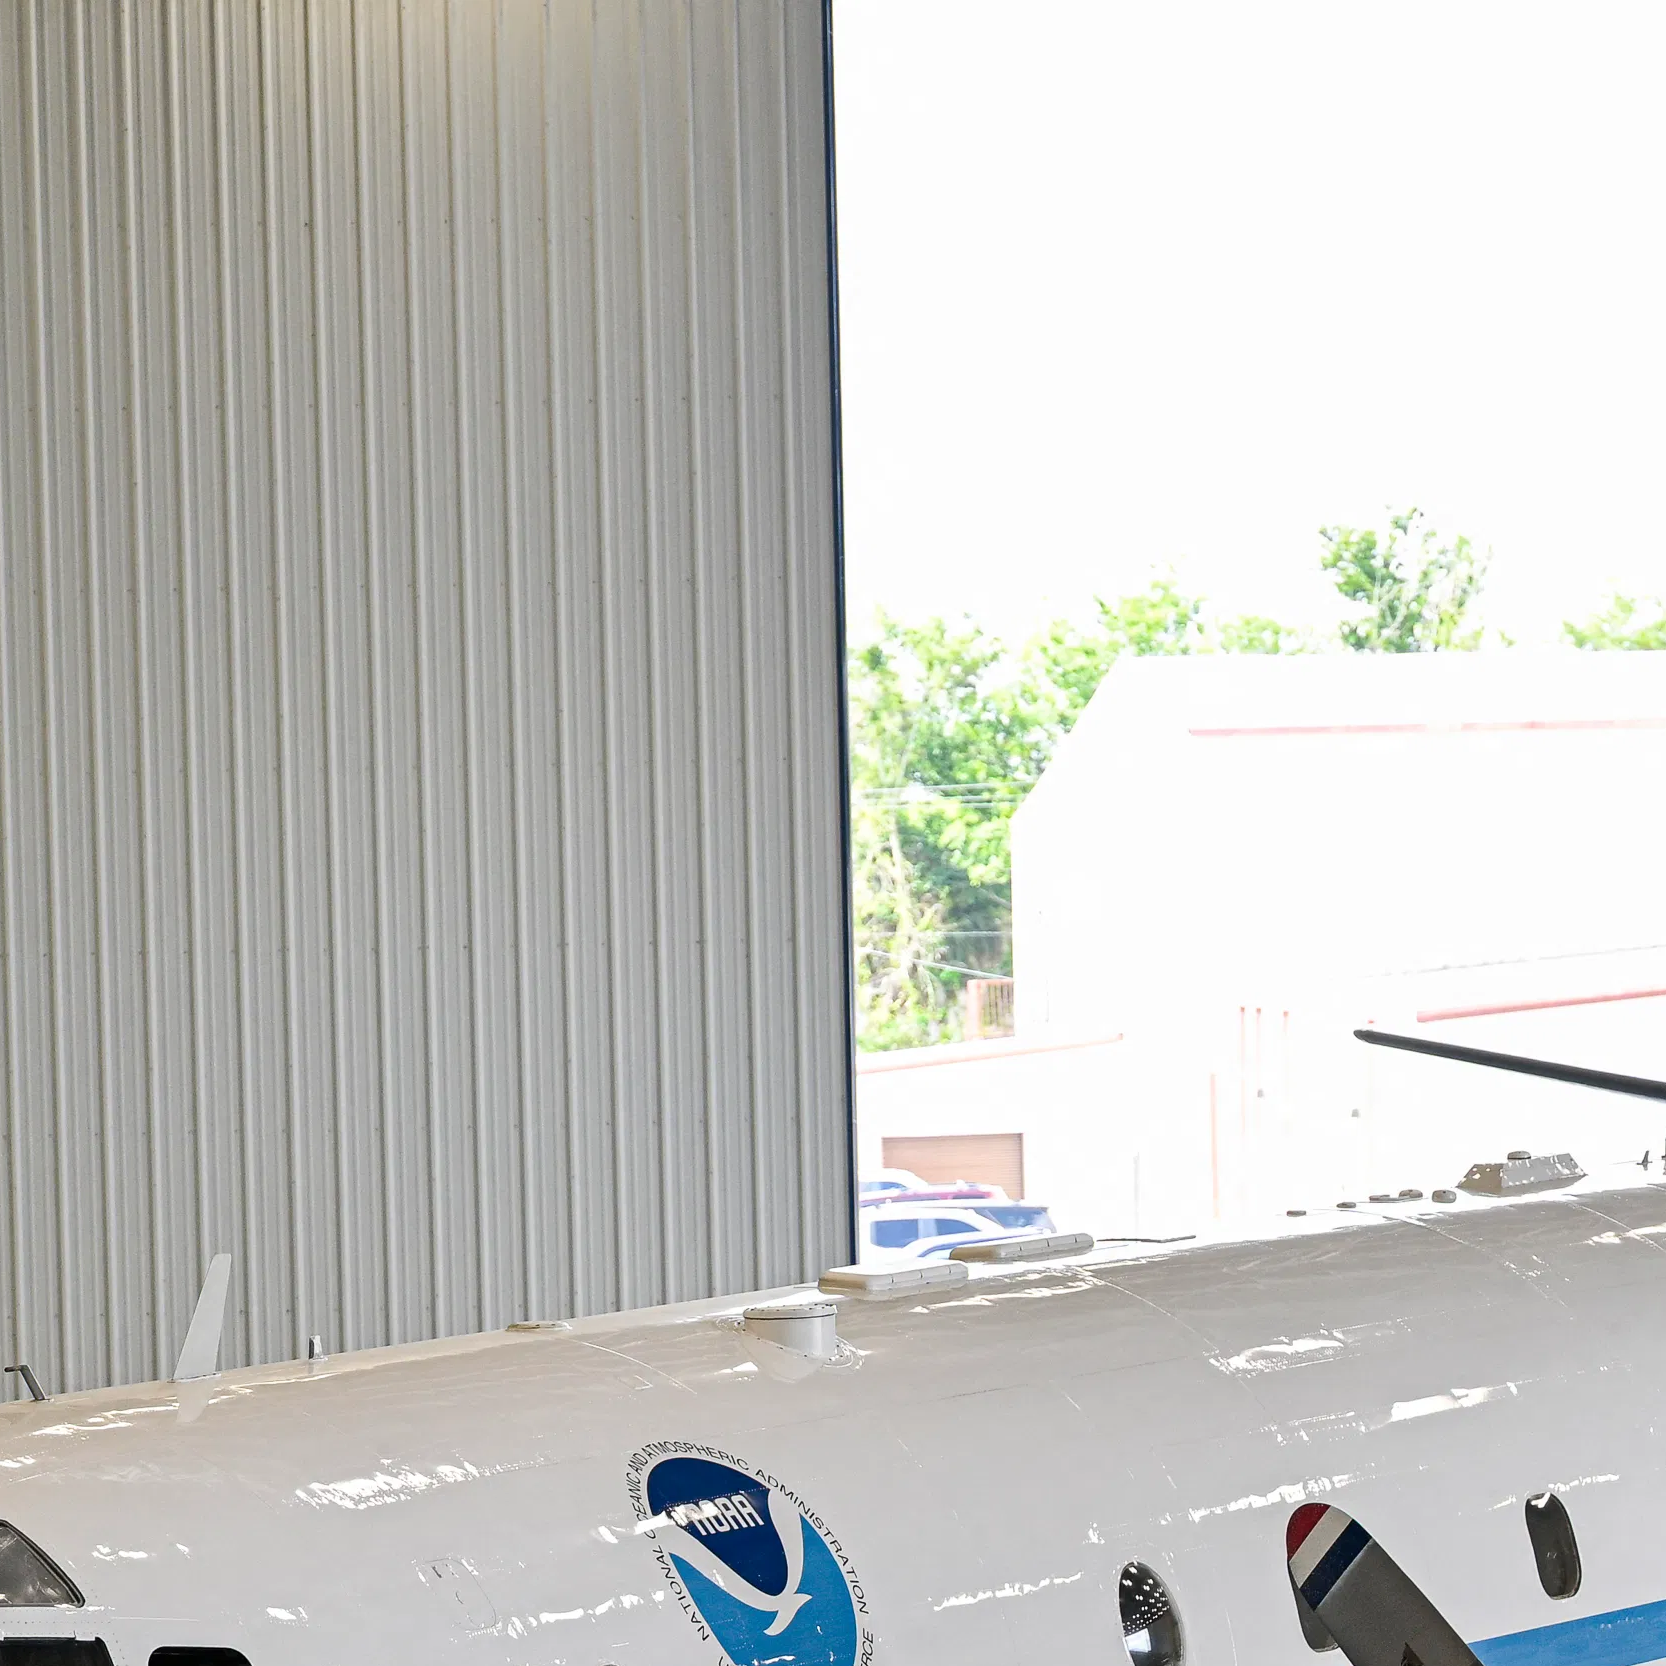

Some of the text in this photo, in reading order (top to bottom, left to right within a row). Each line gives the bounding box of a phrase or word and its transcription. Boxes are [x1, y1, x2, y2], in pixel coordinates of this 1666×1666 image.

[628, 1452, 649, 1476] AND
[641, 1440, 750, 1471] ATMOSPHERIC
[755, 1469, 870, 1614] ADMINISTRATION
[652, 1545, 710, 1641] NATIONAL
